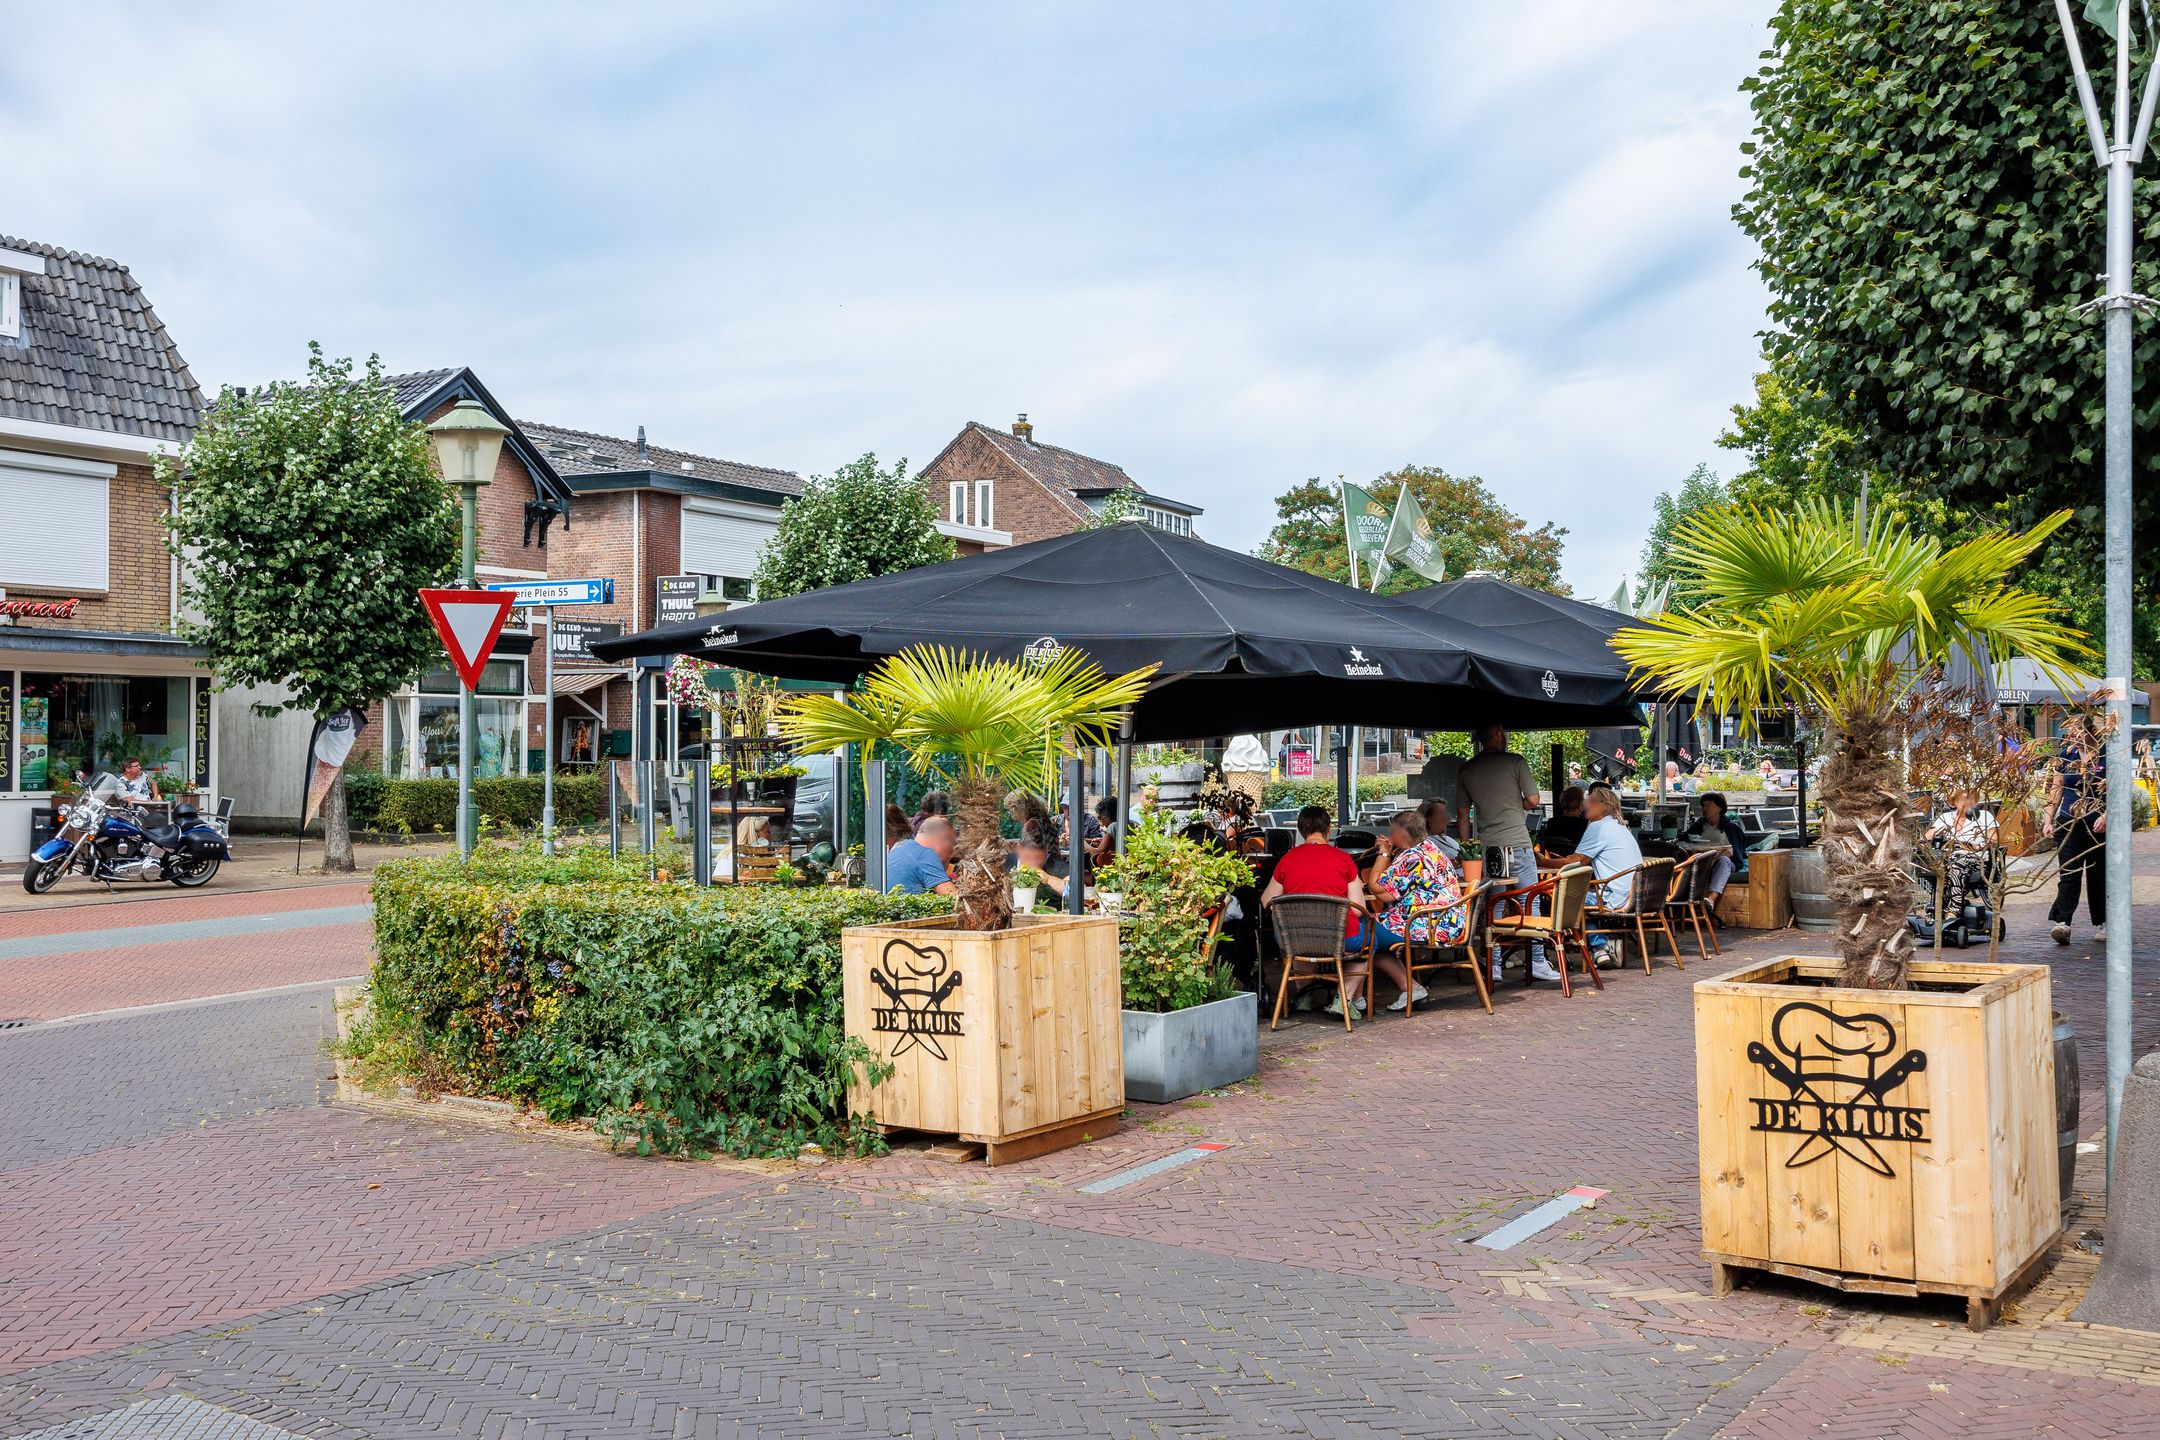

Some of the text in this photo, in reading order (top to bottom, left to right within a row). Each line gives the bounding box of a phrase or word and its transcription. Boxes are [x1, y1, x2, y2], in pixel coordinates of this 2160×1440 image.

[534, 588, 556, 598] Plein
[558, 587, 569, 597] 55
[661, 598, 694, 610] THULE
[661, 612, 696, 622] Hapro
[553, 633, 581, 651] ULE
[701, 631, 739, 647] Heineken
[1344, 663, 1384, 676] Heineken
[1997, 690, 2030, 702] ABELEN
[196, 691, 208, 775] CHRIS
[875, 1008, 962, 1034] DE KLUIS
[1756, 1100, 1925, 1139] DE KLUIS
